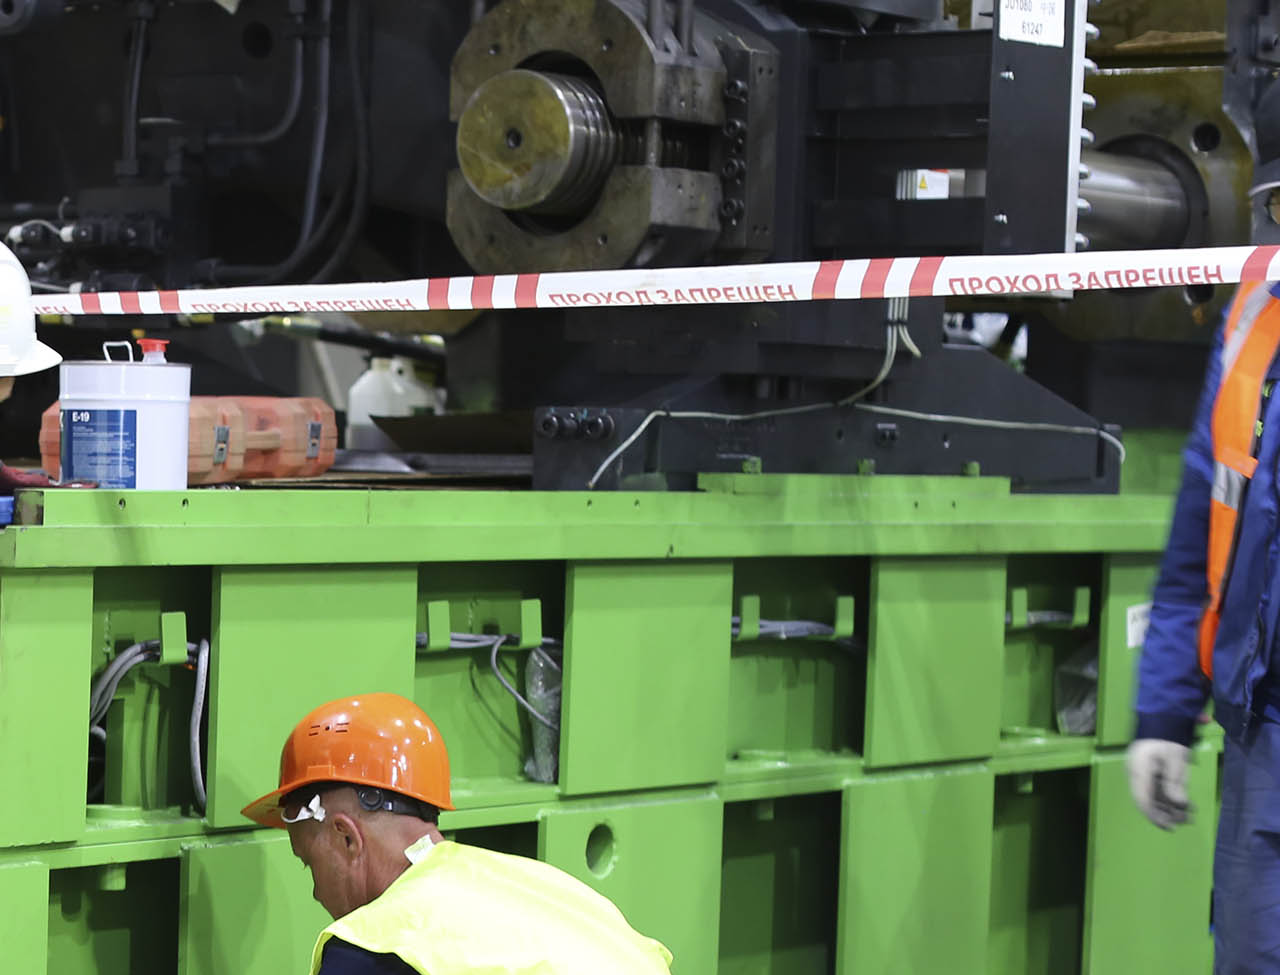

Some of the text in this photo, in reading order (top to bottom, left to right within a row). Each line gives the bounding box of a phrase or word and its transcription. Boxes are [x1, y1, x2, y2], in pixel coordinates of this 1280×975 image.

[948, 265, 1225, 296] ПРОХОД ЗАПРЕЩЕН
[548, 284, 798, 306] ПРОХОД ЗАПРЕЩЕН
[72, 411, 90, 422] E-19
